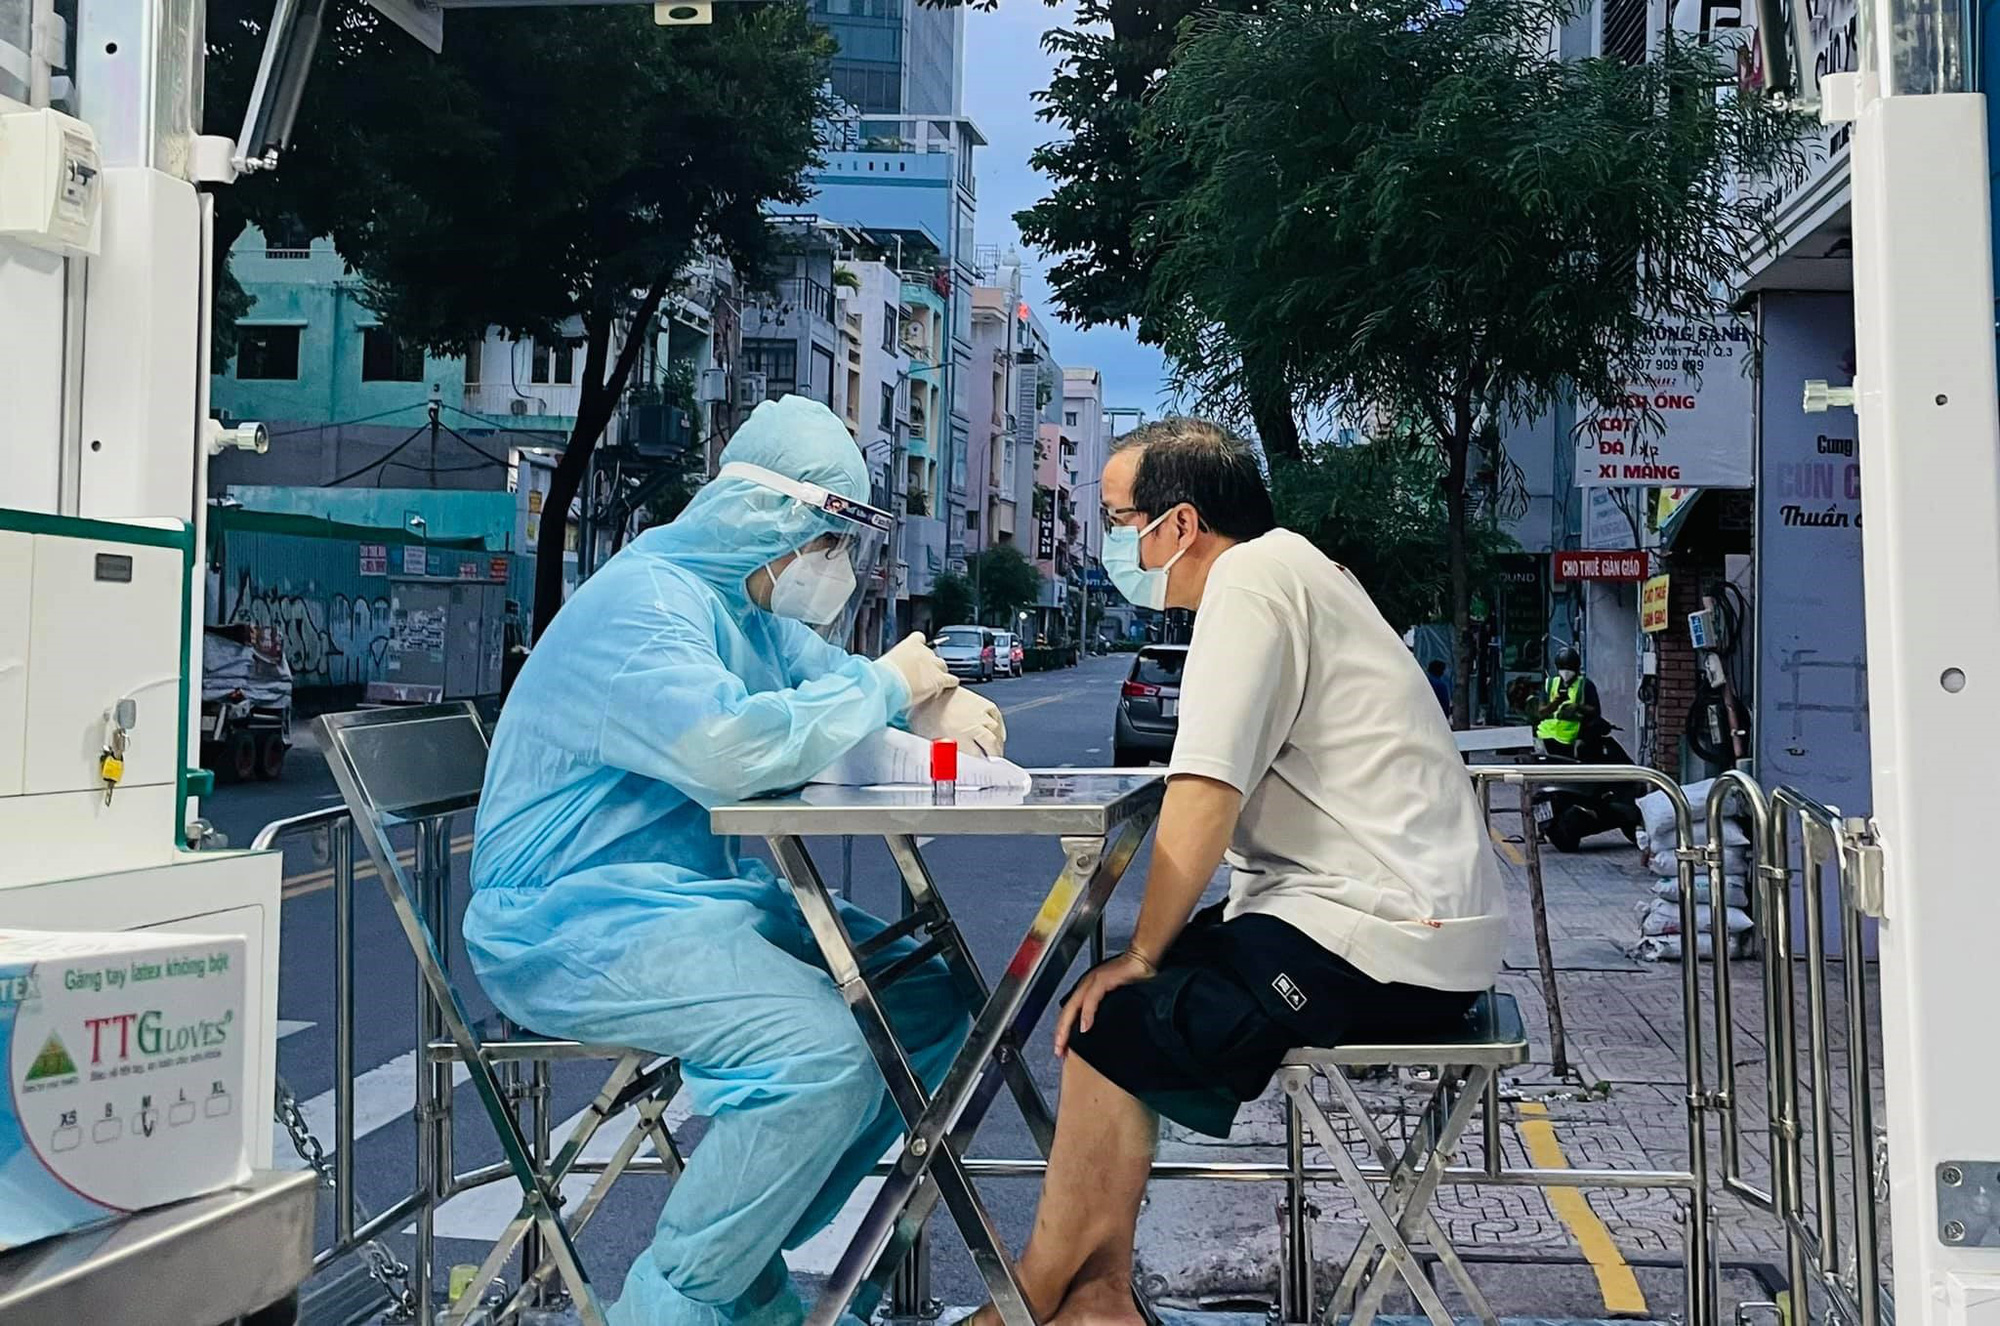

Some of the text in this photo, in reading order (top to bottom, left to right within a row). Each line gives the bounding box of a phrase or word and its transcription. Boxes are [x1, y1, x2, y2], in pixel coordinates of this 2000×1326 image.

[1656, 359, 1678, 370] 909
[1654, 391, 1695, 409] ỐNG
[1817, 435, 1853, 457] Cung
[1599, 465, 1617, 478] XI
[1780, 503, 1849, 527] Thuần
[1562, 560, 1579, 577] CHO
[1621, 555, 1640, 577] GIÁO
[106, 968, 126, 988] tay
